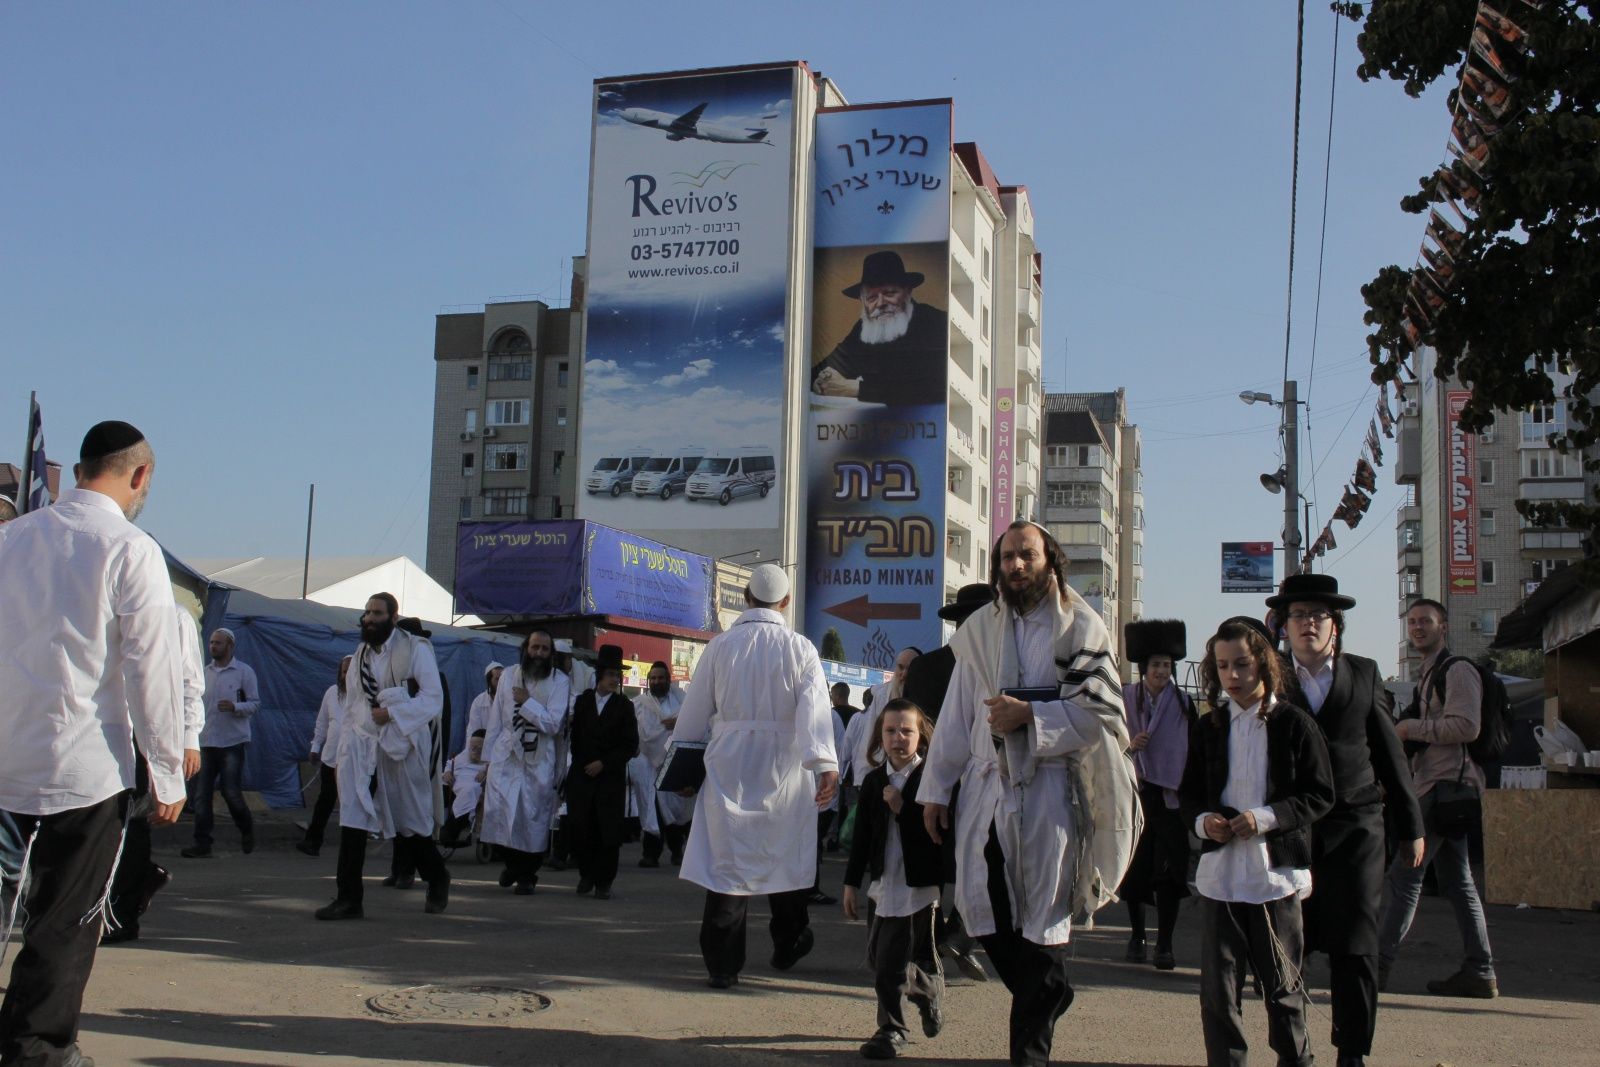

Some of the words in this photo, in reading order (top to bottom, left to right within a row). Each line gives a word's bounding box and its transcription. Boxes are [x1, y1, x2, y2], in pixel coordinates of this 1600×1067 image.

[837, 128, 928, 167] מלון
[821, 173, 869, 206] ציון
[875, 169, 941, 190] שערי
[625, 174, 738, 218] Revivo's
[633, 227, 656, 238] רגוע
[660, 223, 691, 236] להגיע
[703, 222, 740, 233] רביבוס
[630, 239, 740, 261] 03-5747700
[628, 262, 740, 279] www.revivos.co.il
[834, 462, 918, 499] בית
[997, 421, 1009, 518] SHAAREI
[474, 534, 496, 550] ציון
[500, 533, 531, 546] שערי
[534, 531, 567, 545] הוטל
[1453, 519, 1472, 562] אומן
[620, 541, 639, 568] ציון
[641, 547, 665, 571] שערי
[664, 549, 688, 578] הוטל
[815, 569, 872, 586] CHABAD
[877, 568, 934, 586] MINYAN
